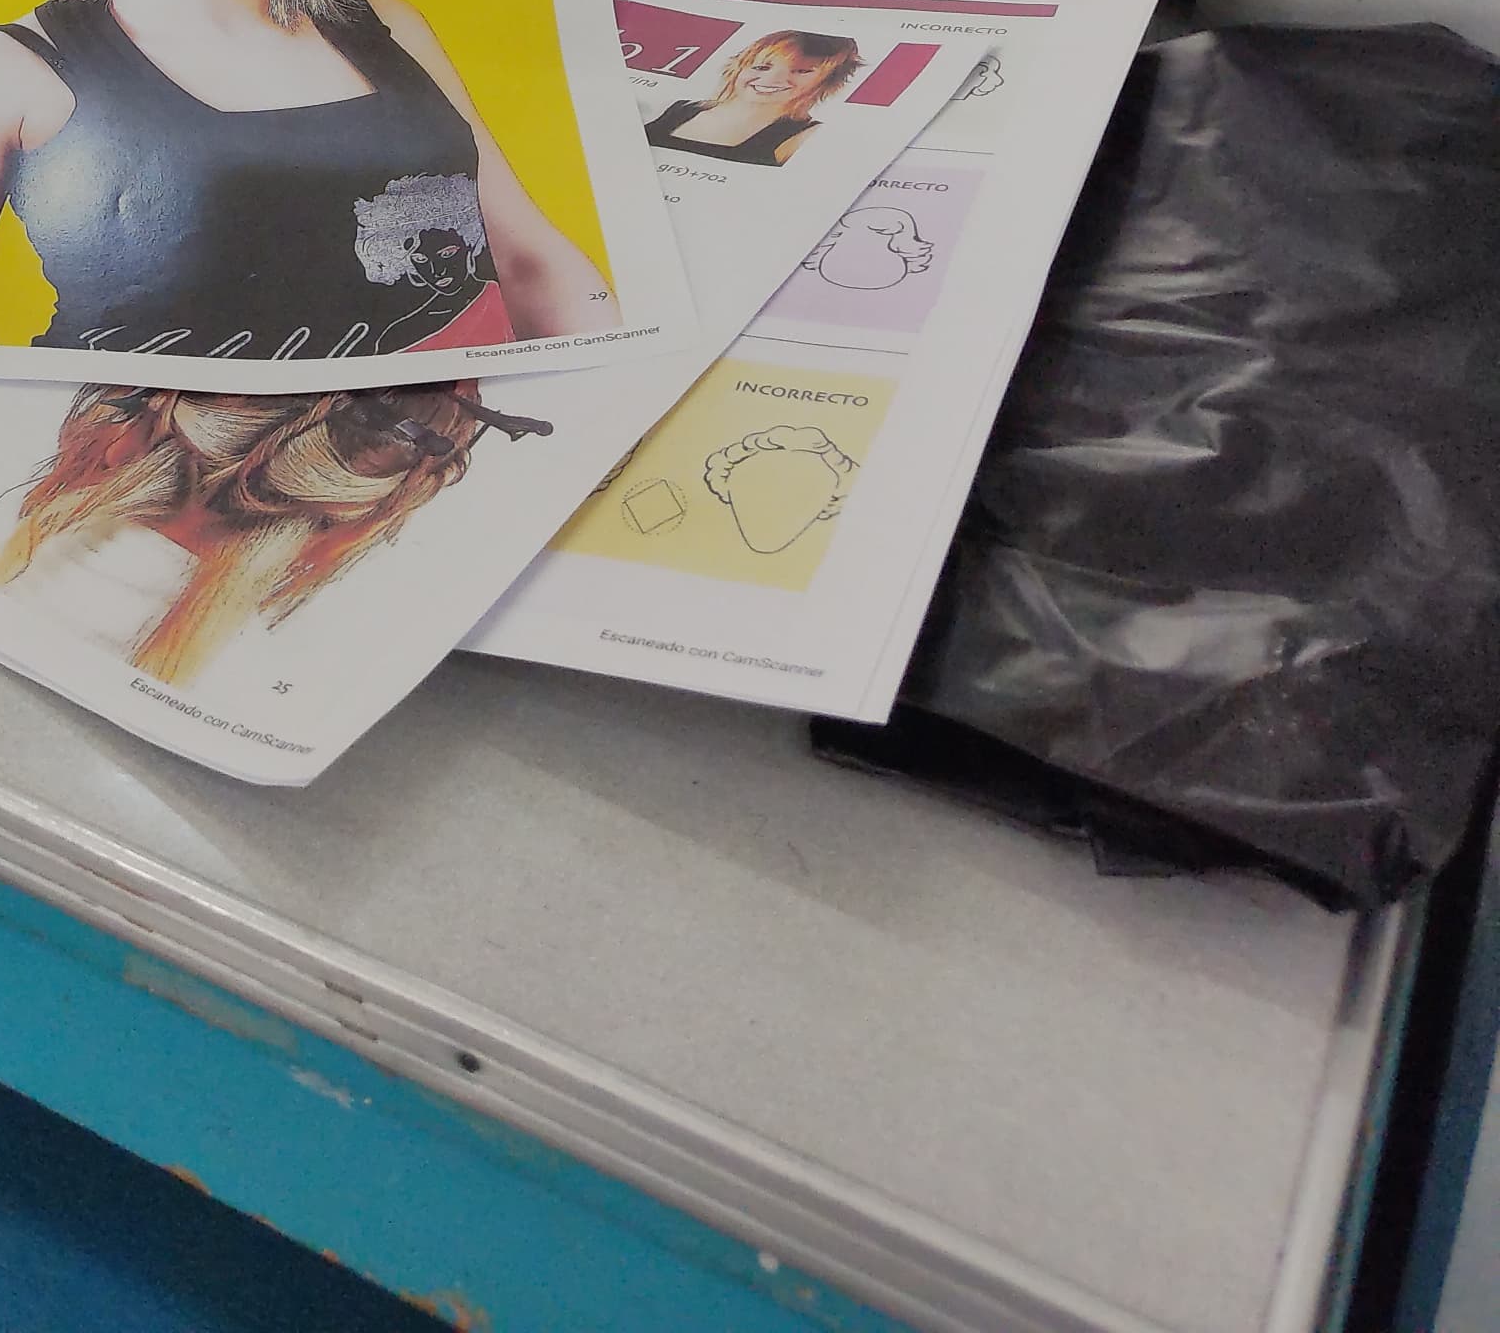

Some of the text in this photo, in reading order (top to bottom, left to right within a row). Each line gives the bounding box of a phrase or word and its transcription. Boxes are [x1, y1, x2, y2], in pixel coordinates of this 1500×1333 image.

[900, 22, 1008, 35] INCORRECTO
[652, 45, 701, 75] 1
[588, 291, 609, 301] 29
[465, 325, 661, 359] Escaneado con CamScanner
[735, 380, 870, 407] INCORRECTO
[599, 629, 827, 678] Escaneado con CamScanner
[271, 680, 293, 695] 25
[129, 677, 316, 755] Escaneado con CamScanner
